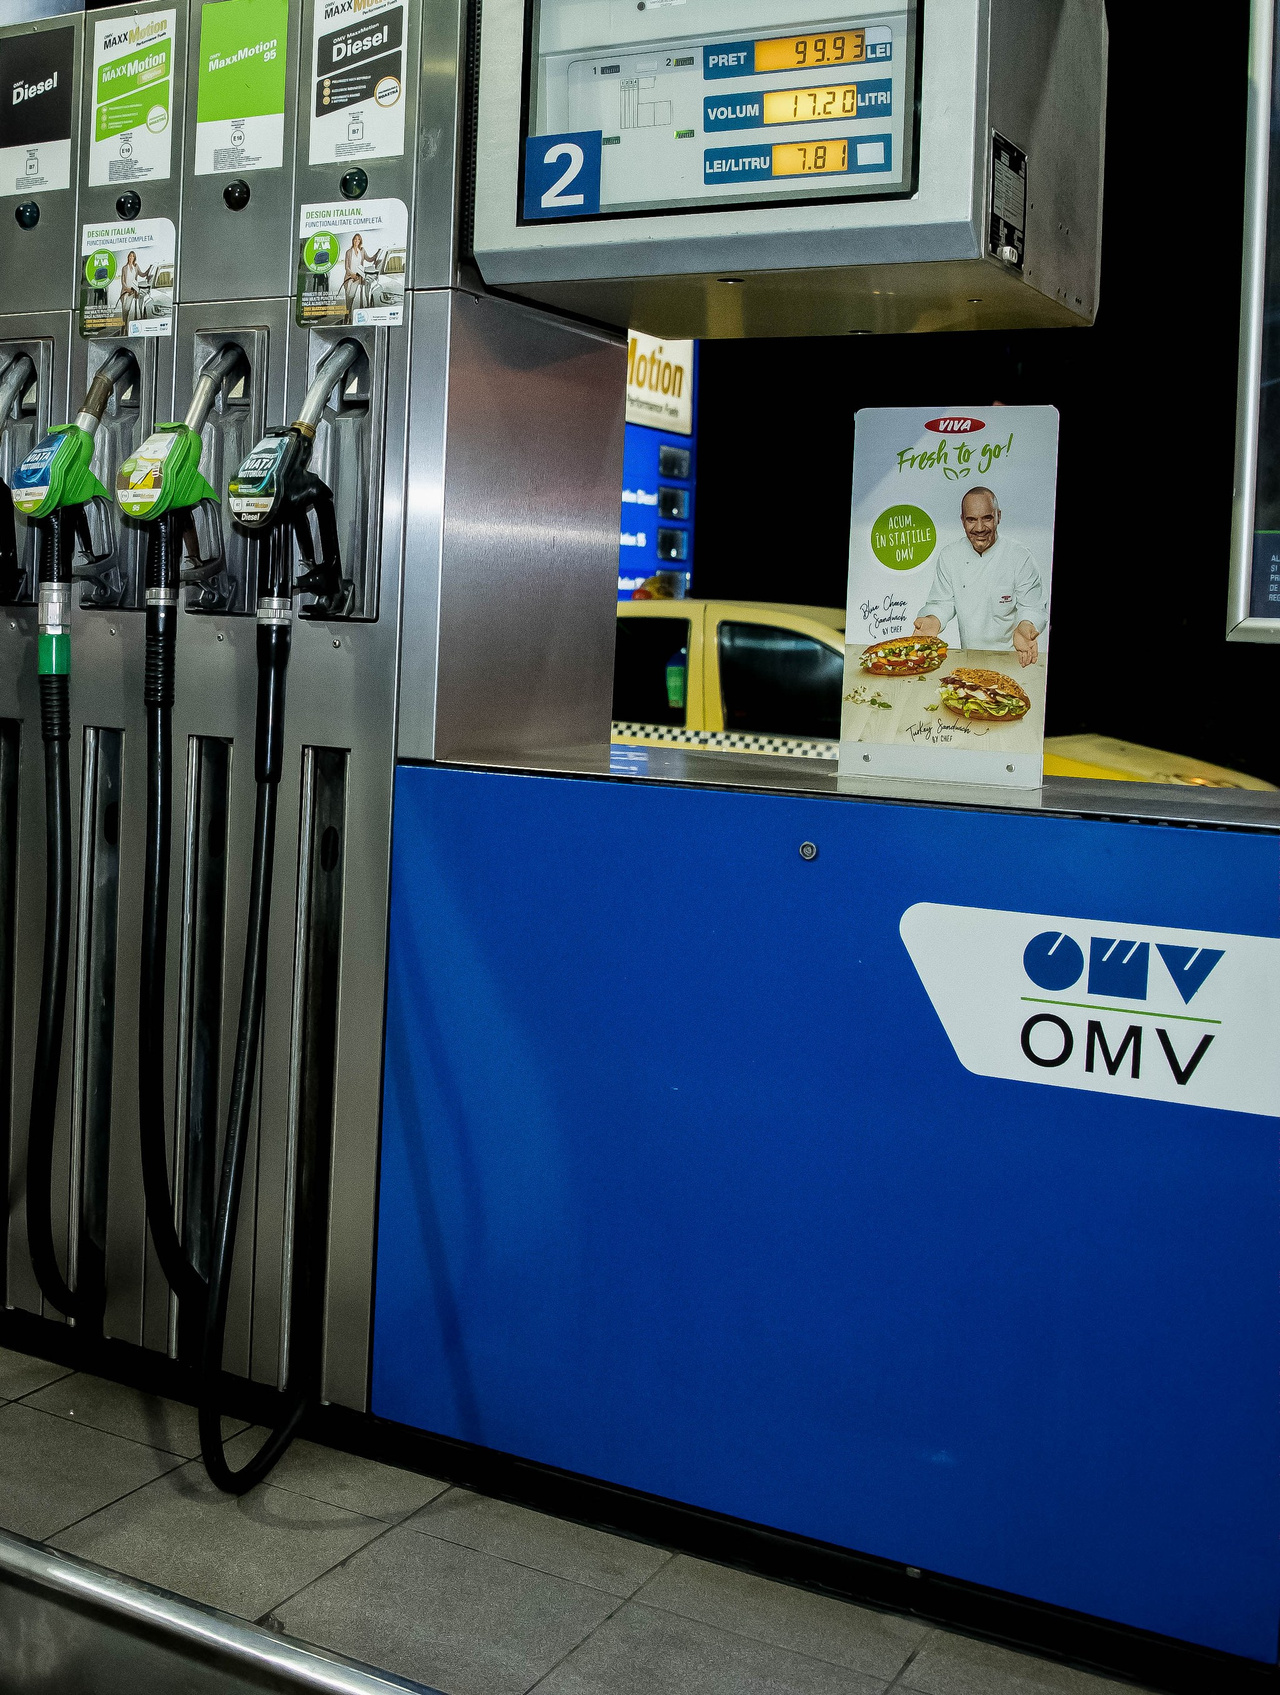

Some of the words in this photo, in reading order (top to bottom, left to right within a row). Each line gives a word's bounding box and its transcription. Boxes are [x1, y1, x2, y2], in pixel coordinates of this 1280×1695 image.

[103, 19, 168, 50] MAXXMotion
[332, 35, 347, 44] OMV
[346, 23, 380, 39] MaxxMotion
[332, 25, 389, 63] Diesel
[208, 39, 278, 72] MaxxMotion
[263, 49, 277, 63] 95
[708, 52, 747, 67] PRET
[794, 34, 864, 64] 99.93
[866, 44, 891, 58] LEI
[102, 52, 166, 83] MAXXMotion
[592, 66, 597, 75] 1
[665, 58, 672, 66] 2
[12, 71, 58, 105] Diesel
[707, 104, 760, 120] VOLUM
[792, 89, 855, 118] 17.20
[857, 91, 891, 107] LITRI
[705, 156, 770, 173] LEI/LITRU
[797, 145, 847, 170] 7.81
[541, 143, 584, 208] 2
[305, 210, 331, 219] DESIGN
[87, 229, 110, 239] DESIGN
[939, 419, 972, 431] VIVA
[897, 439, 949, 473] Fresh
[952, 441, 977, 464] to
[978, 433, 1014, 474] go!
[241, 513, 260, 521] Diesel
[875, 532, 887, 548] ÎN
[889, 528, 932, 547] STAȚIILE
[895, 547, 914, 562] OMV
[860, 600, 879, 620] Blue
[883, 594, 908, 611] Cheese
[873, 608, 907, 628] Sandwich
[882, 627, 889, 635] BY
[890, 625, 902, 634] CHEF
[905, 720, 933, 742] Turkey
[937, 718, 972, 734] Sandwich
[931, 735, 938, 743] BY
[940, 734, 953, 742] CHEF
[1020, 1013, 1215, 1086] OMV
